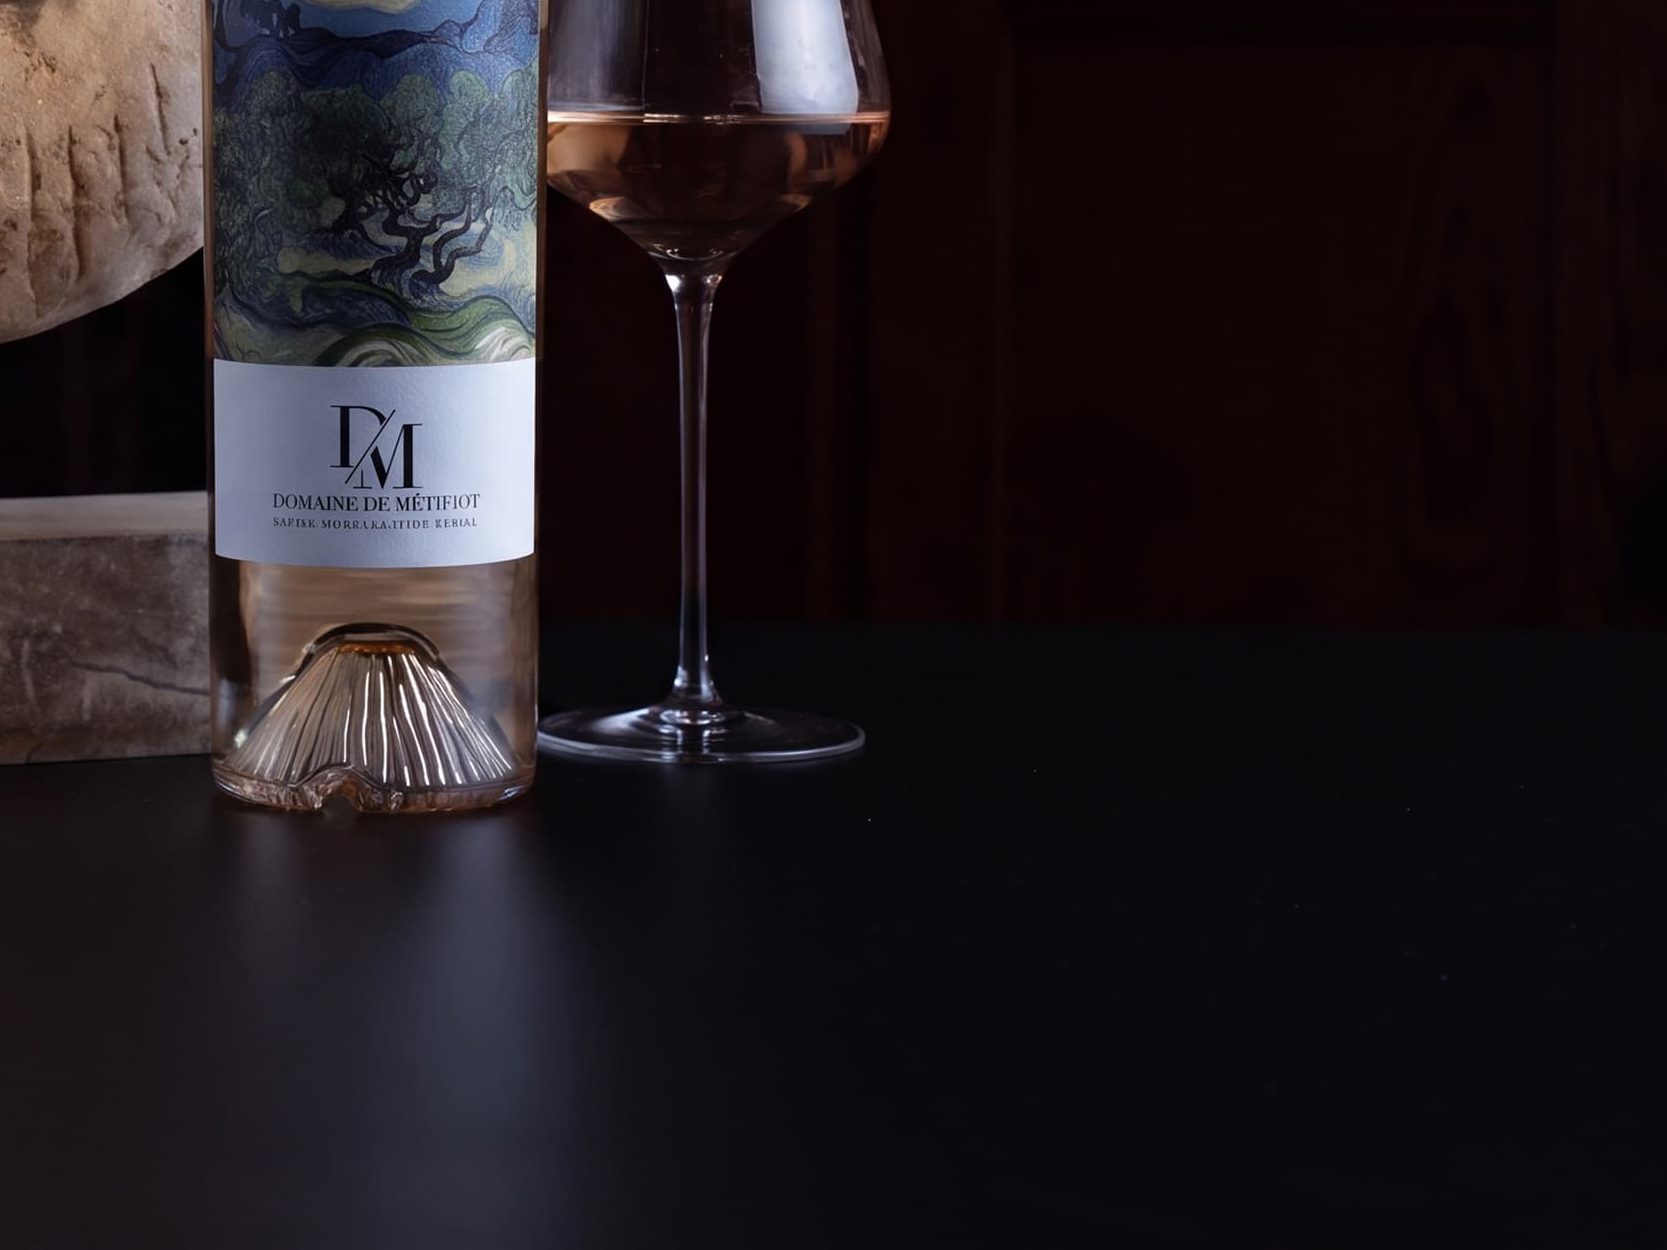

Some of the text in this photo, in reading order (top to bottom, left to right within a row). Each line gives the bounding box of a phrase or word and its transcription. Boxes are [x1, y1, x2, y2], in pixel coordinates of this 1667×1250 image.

[273, 492, 480, 512] DOMAINE DE MÉTIFIOT
